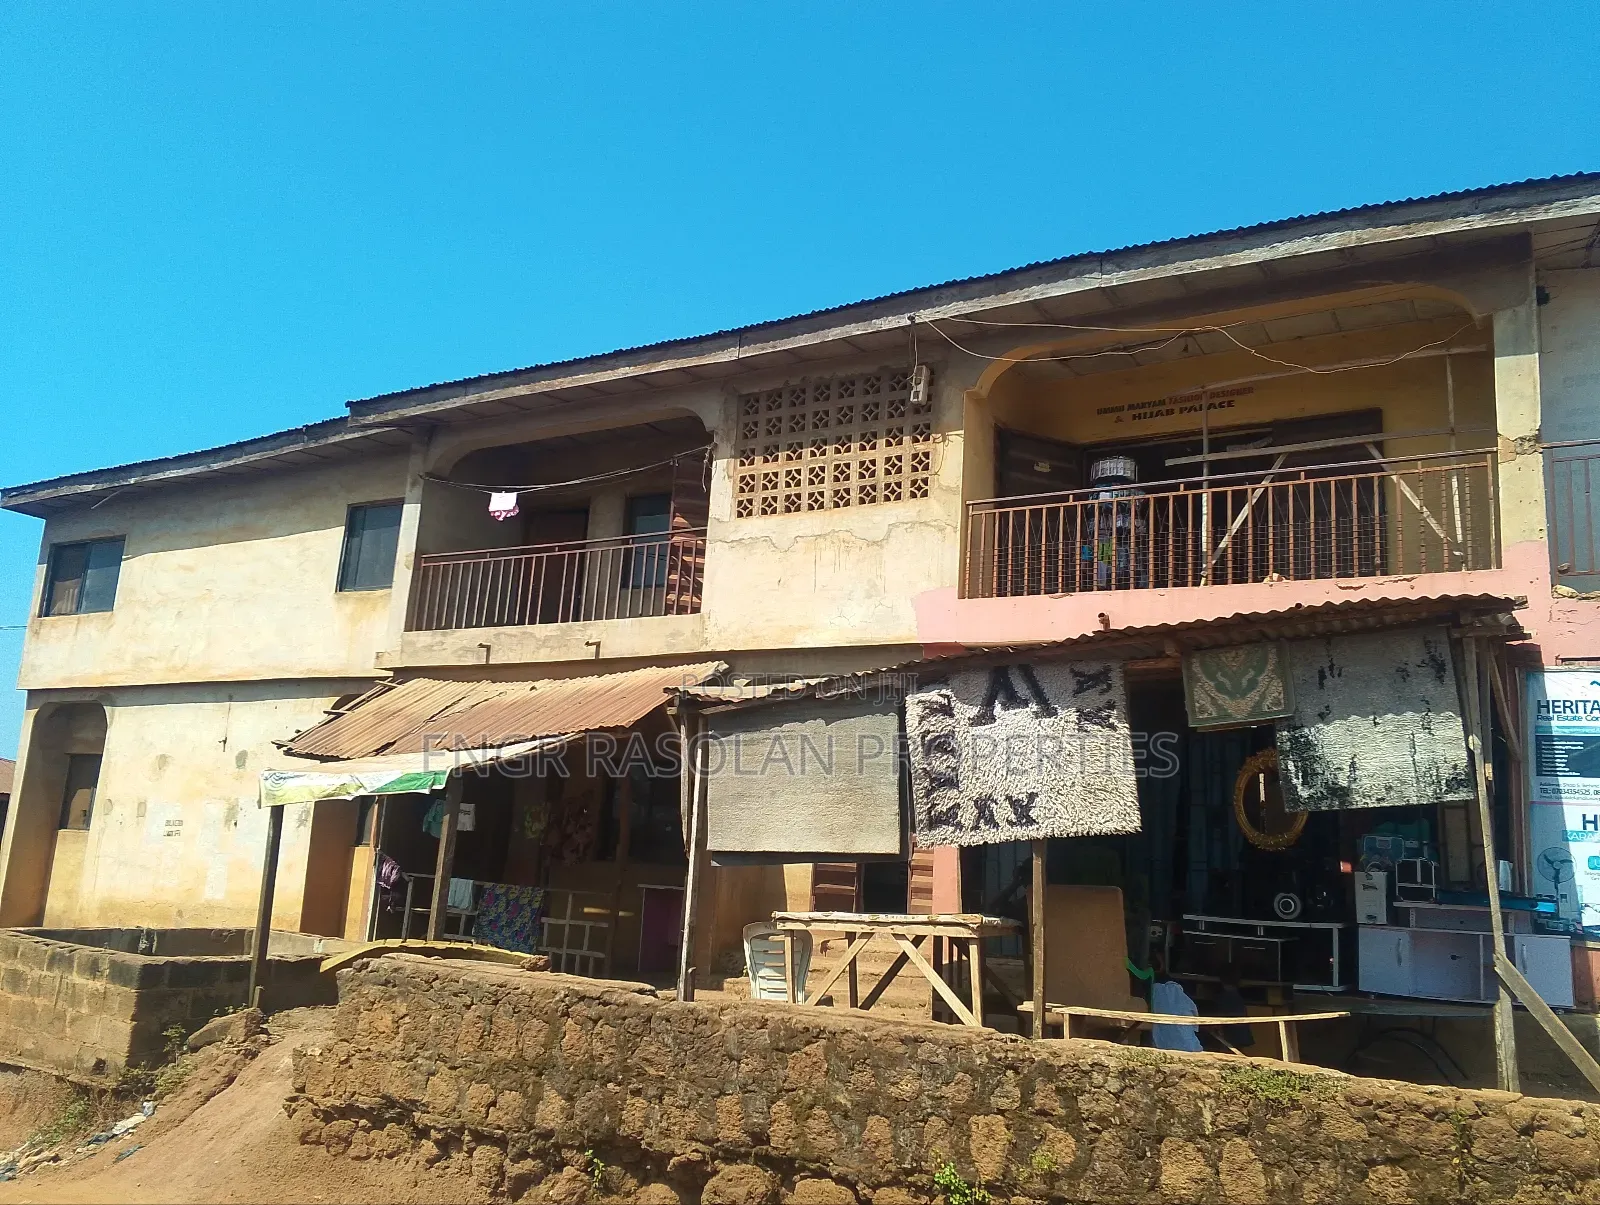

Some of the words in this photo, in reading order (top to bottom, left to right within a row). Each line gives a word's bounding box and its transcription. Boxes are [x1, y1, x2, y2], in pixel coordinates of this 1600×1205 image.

[1127, 398, 1166, 412] MARYAM
[1208, 386, 1254, 400] DESIGNER
[1114, 415, 1124, 424] &
[1131, 408, 1175, 421] HIJAB
[1536, 714, 1555, 722] Real
[1556, 714, 1584, 722] Estate
